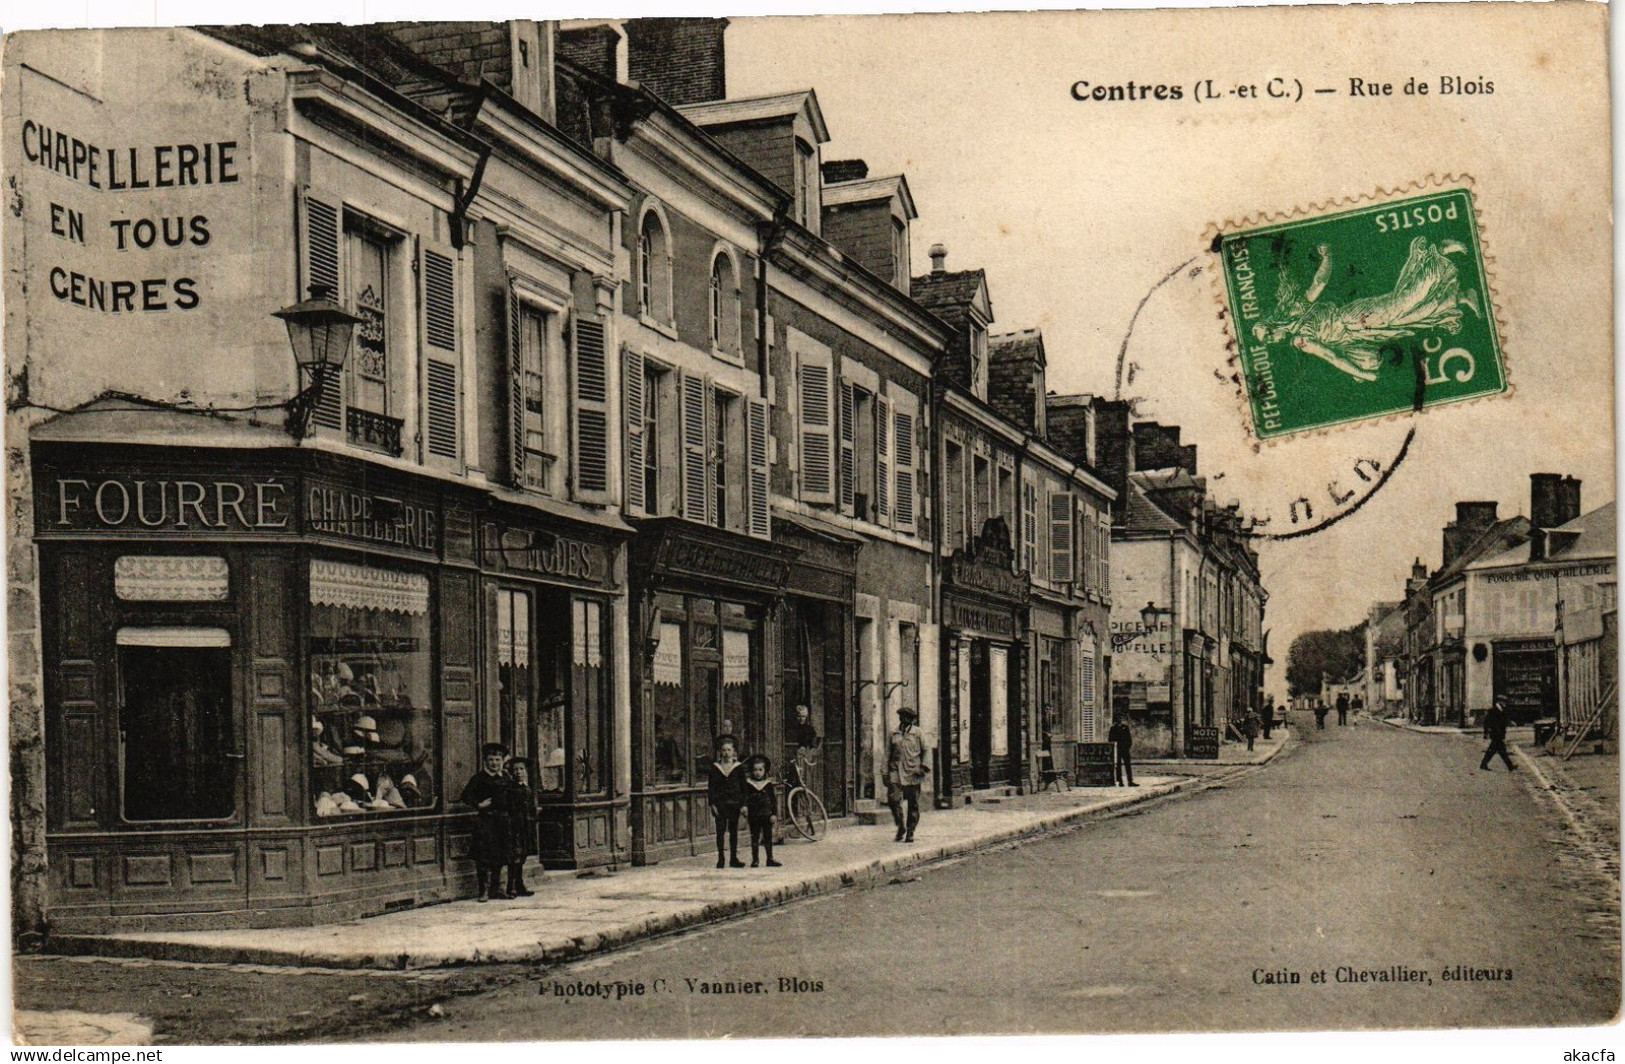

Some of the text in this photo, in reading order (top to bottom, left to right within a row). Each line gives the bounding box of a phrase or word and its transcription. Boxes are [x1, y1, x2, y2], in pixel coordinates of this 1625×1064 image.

[22, 119, 239, 190] CHAPELLERIE
[50, 203, 210, 250] EN TOUS
[1375, 201, 1458, 233] POSTES
[50, 267, 200, 312] GENRES
[56, 478, 288, 527] FOURRÉ
